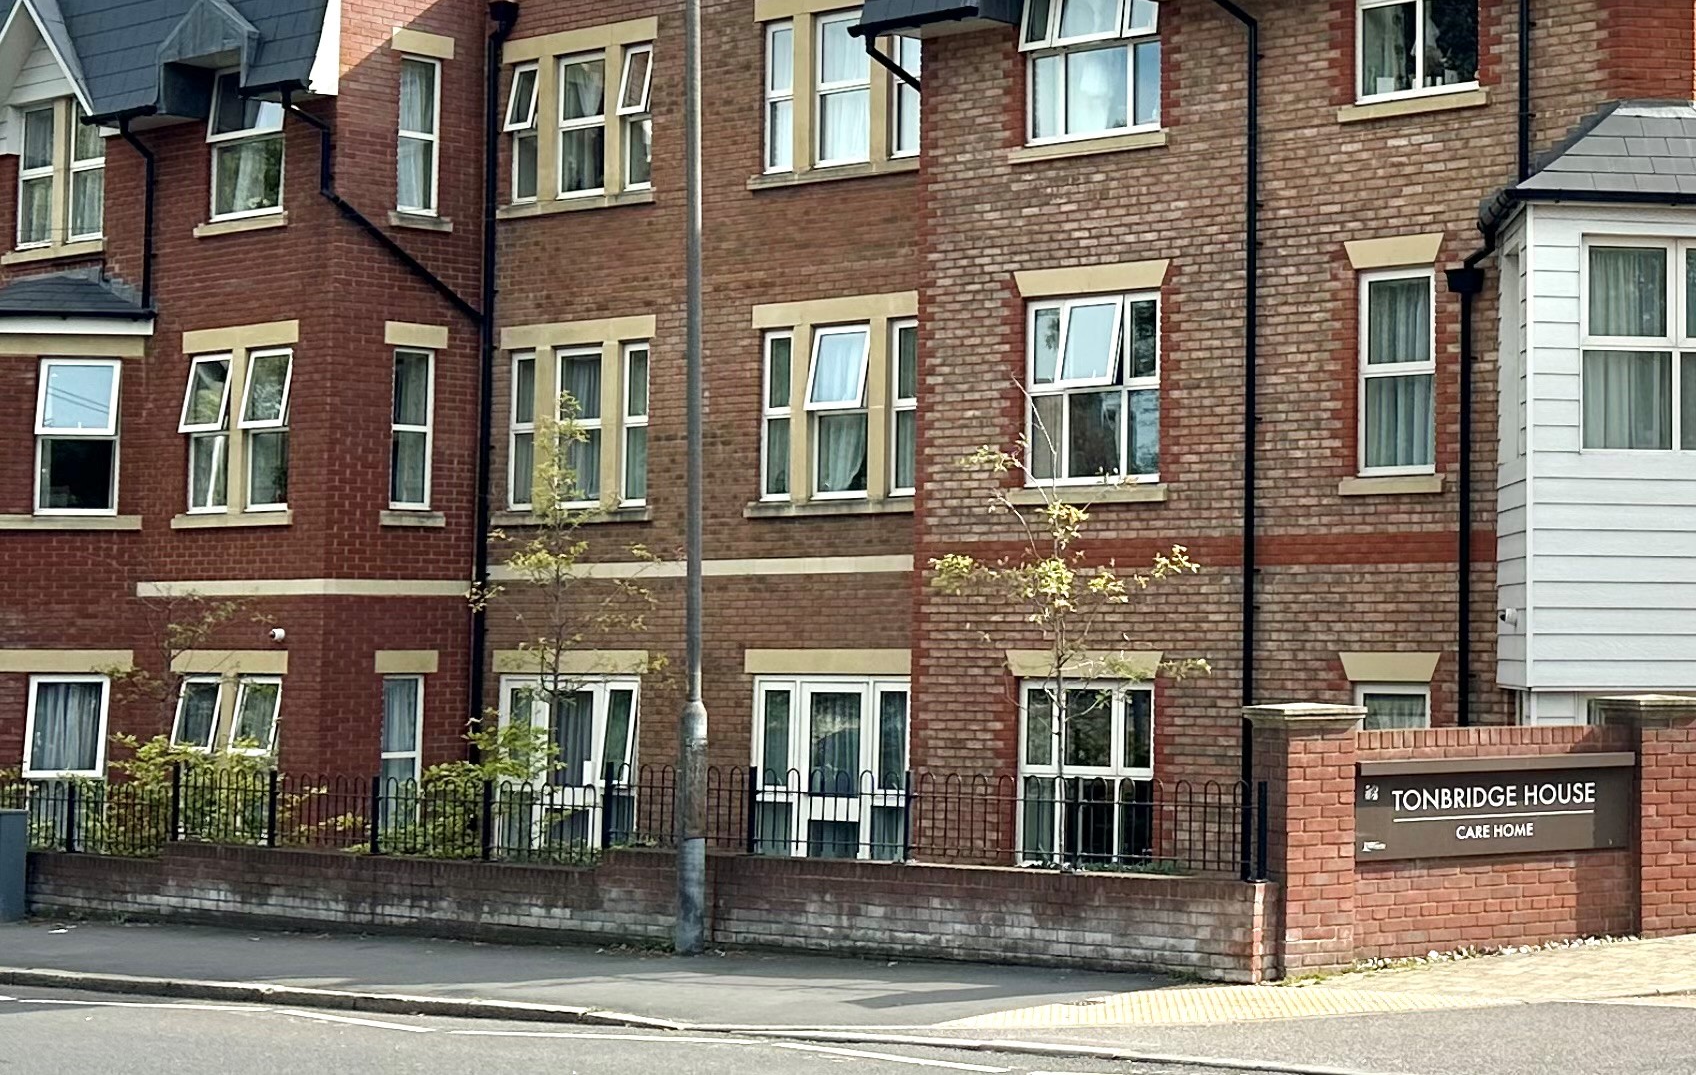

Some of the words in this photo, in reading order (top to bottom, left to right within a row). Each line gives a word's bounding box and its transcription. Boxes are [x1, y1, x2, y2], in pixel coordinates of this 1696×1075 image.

[1391, 785, 1518, 812] TONBRIDGE
[1524, 782, 1596, 806] HOUSE
[1455, 824, 1491, 840] CARE
[1493, 822, 1534, 838] HOME
